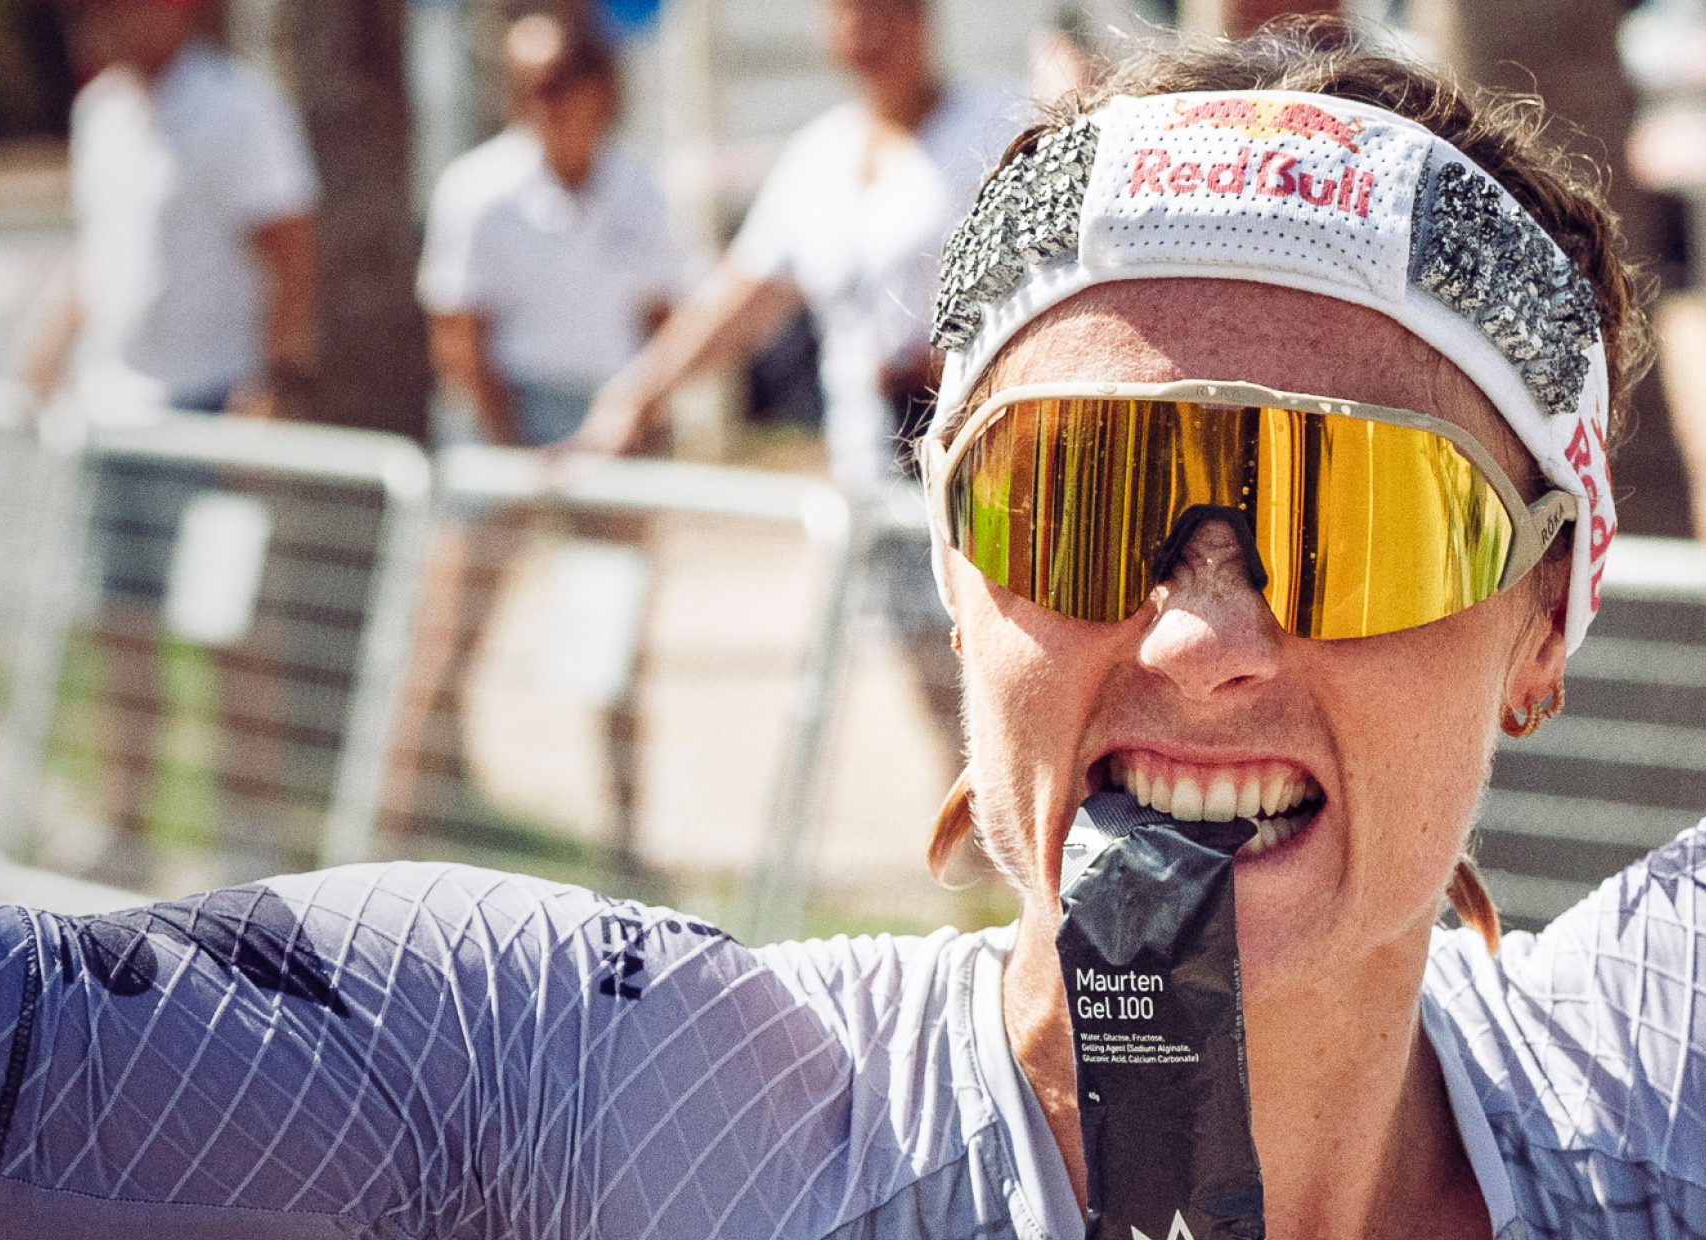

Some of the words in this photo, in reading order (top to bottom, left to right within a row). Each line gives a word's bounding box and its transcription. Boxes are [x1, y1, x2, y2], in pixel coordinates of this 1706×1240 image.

[1129, 146, 1252, 195] Red
[1255, 150, 1375, 218] Bull
[1076, 967, 1164, 992] Maurten
[1077, 995, 1113, 1019] Gel
[1117, 996, 1154, 1020] 100
[1132, 1033, 1165, 1042] Fructose,
[1081, 1043, 1104, 1054] Gelling
[1128, 1054, 1157, 1064] Calcium
